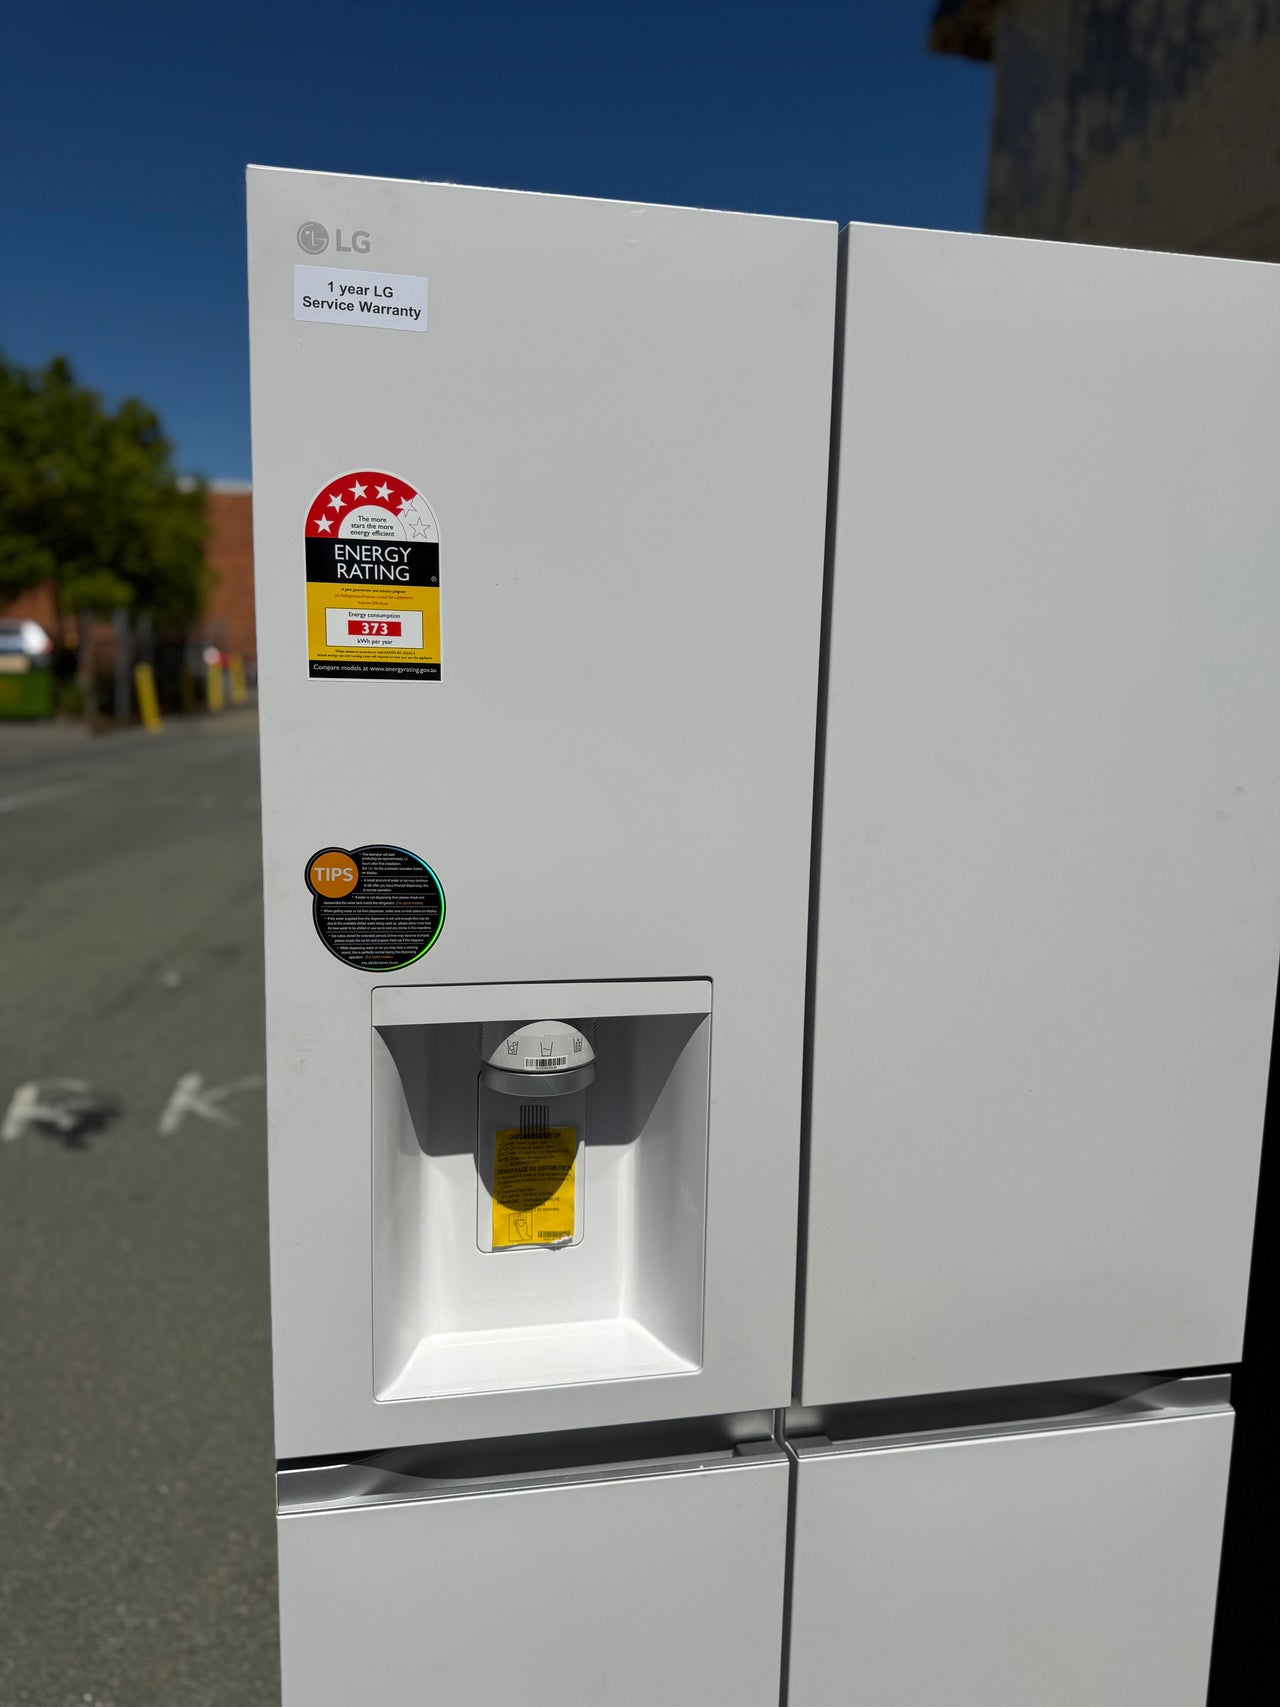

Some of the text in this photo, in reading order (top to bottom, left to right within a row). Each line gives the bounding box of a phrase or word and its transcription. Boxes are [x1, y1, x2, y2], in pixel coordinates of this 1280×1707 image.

[336, 229, 370, 254] LG
[328, 281, 393, 298] 1 year LG
[302, 296, 421, 320] Service Warranty
[335, 544, 411, 563] ENERGY
[337, 563, 410, 581] RATING
[361, 623, 388, 635] 373
[370, 666, 437, 674] www.energyrating.gov.au
[314, 867, 353, 882] TIPS
